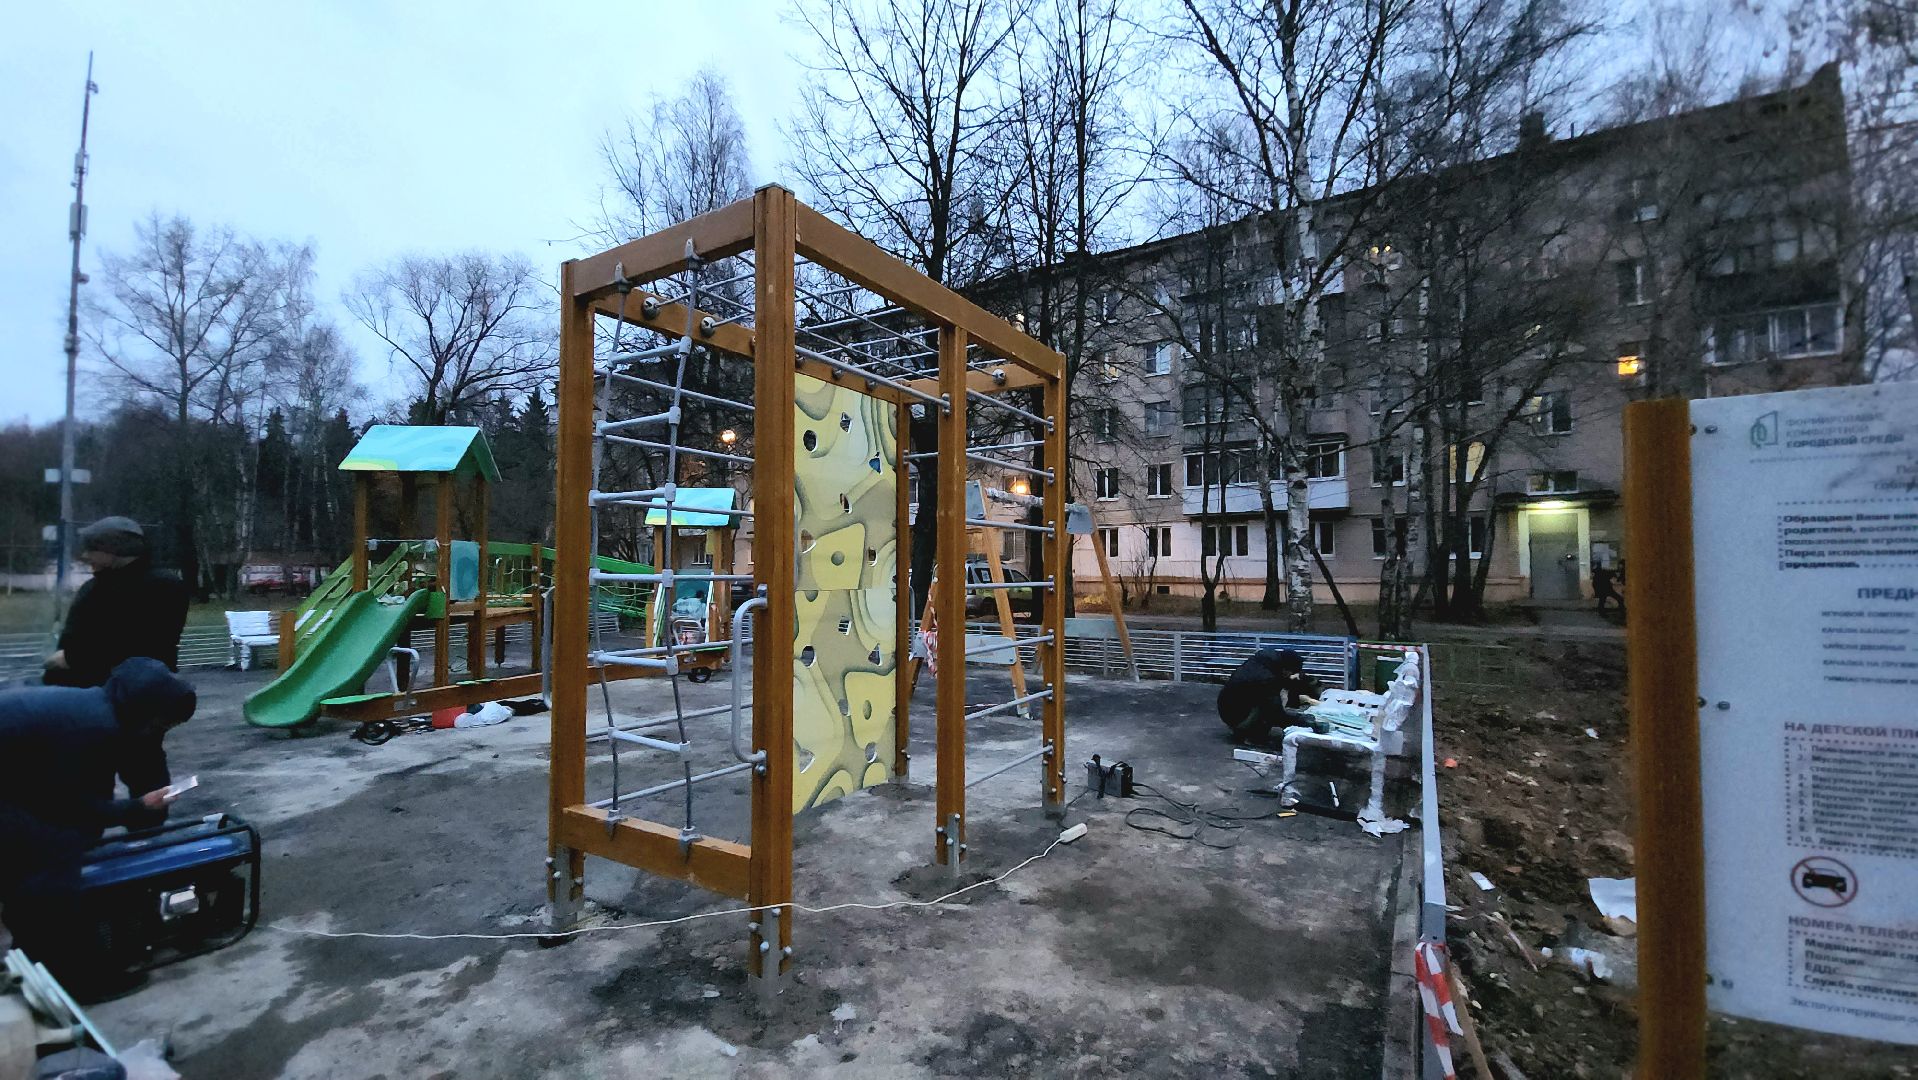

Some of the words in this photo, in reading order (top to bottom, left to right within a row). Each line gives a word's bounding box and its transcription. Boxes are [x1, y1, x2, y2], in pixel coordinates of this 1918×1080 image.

[1787, 435, 1858, 449] ГОРОДСКОЙ
[1861, 434, 1905, 445] СРЕДЫ
[1783, 514, 1853, 525] Обращаем
[1784, 526, 1856, 536] родителей,
[1784, 549, 1825, 558] Перед
[1784, 722, 1807, 732] НА
[1811, 724, 1888, 737] ДЕТСКОЙ
[1788, 916, 1854, 934] НОМЕРА
[1805, 939, 1897, 959] Медицинская
[1805, 950, 1865, 966] Полиция
[1804, 974, 1854, 989] Служба
